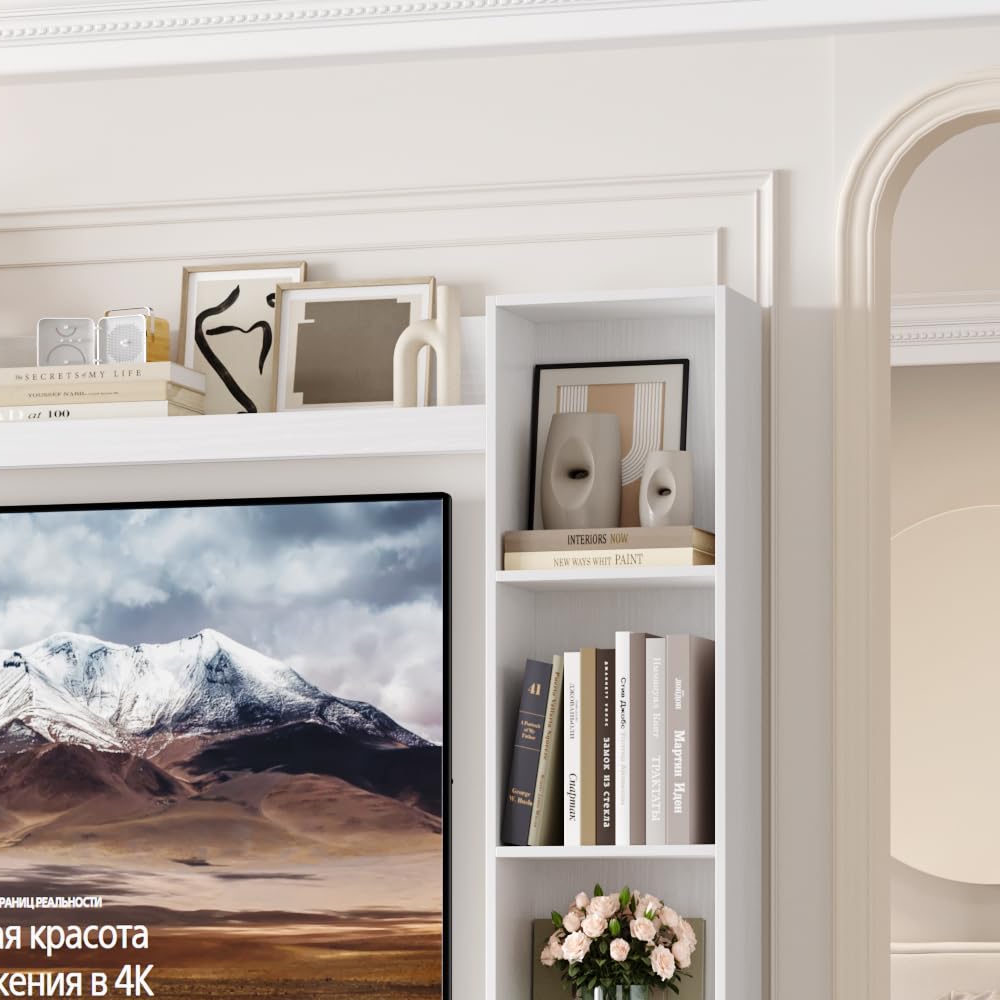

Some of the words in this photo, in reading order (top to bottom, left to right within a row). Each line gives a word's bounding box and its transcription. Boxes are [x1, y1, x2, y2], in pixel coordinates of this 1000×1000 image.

[25, 371, 80, 381] SECRETS
[88, 370, 106, 379] MY
[114, 369, 143, 378] LIFE
[28, 411, 42, 419] at
[48, 409, 70, 418] 100
[567, 533, 607, 546] INTERIORS
[610, 532, 629, 545] NOW
[553, 557, 570, 568] NEW
[572, 556, 591, 567] WAYS
[615, 553, 644, 566] PAINT
[619, 700, 628, 729] Джобс
[603, 737, 611, 770] замок
[671, 730, 686, 777] Мартин
[603, 775, 611, 788] из
[651, 755, 661, 822] ТРАКТАТЫ
[567, 773, 578, 822] Спартак
[603, 791, 611, 828] стекла
[673, 783, 686, 814] Иден
[35, 896, 103, 909] РЕАЛЬНОСТИ
[31, 924, 149, 957] красота
[91, 972, 107, 996] в
